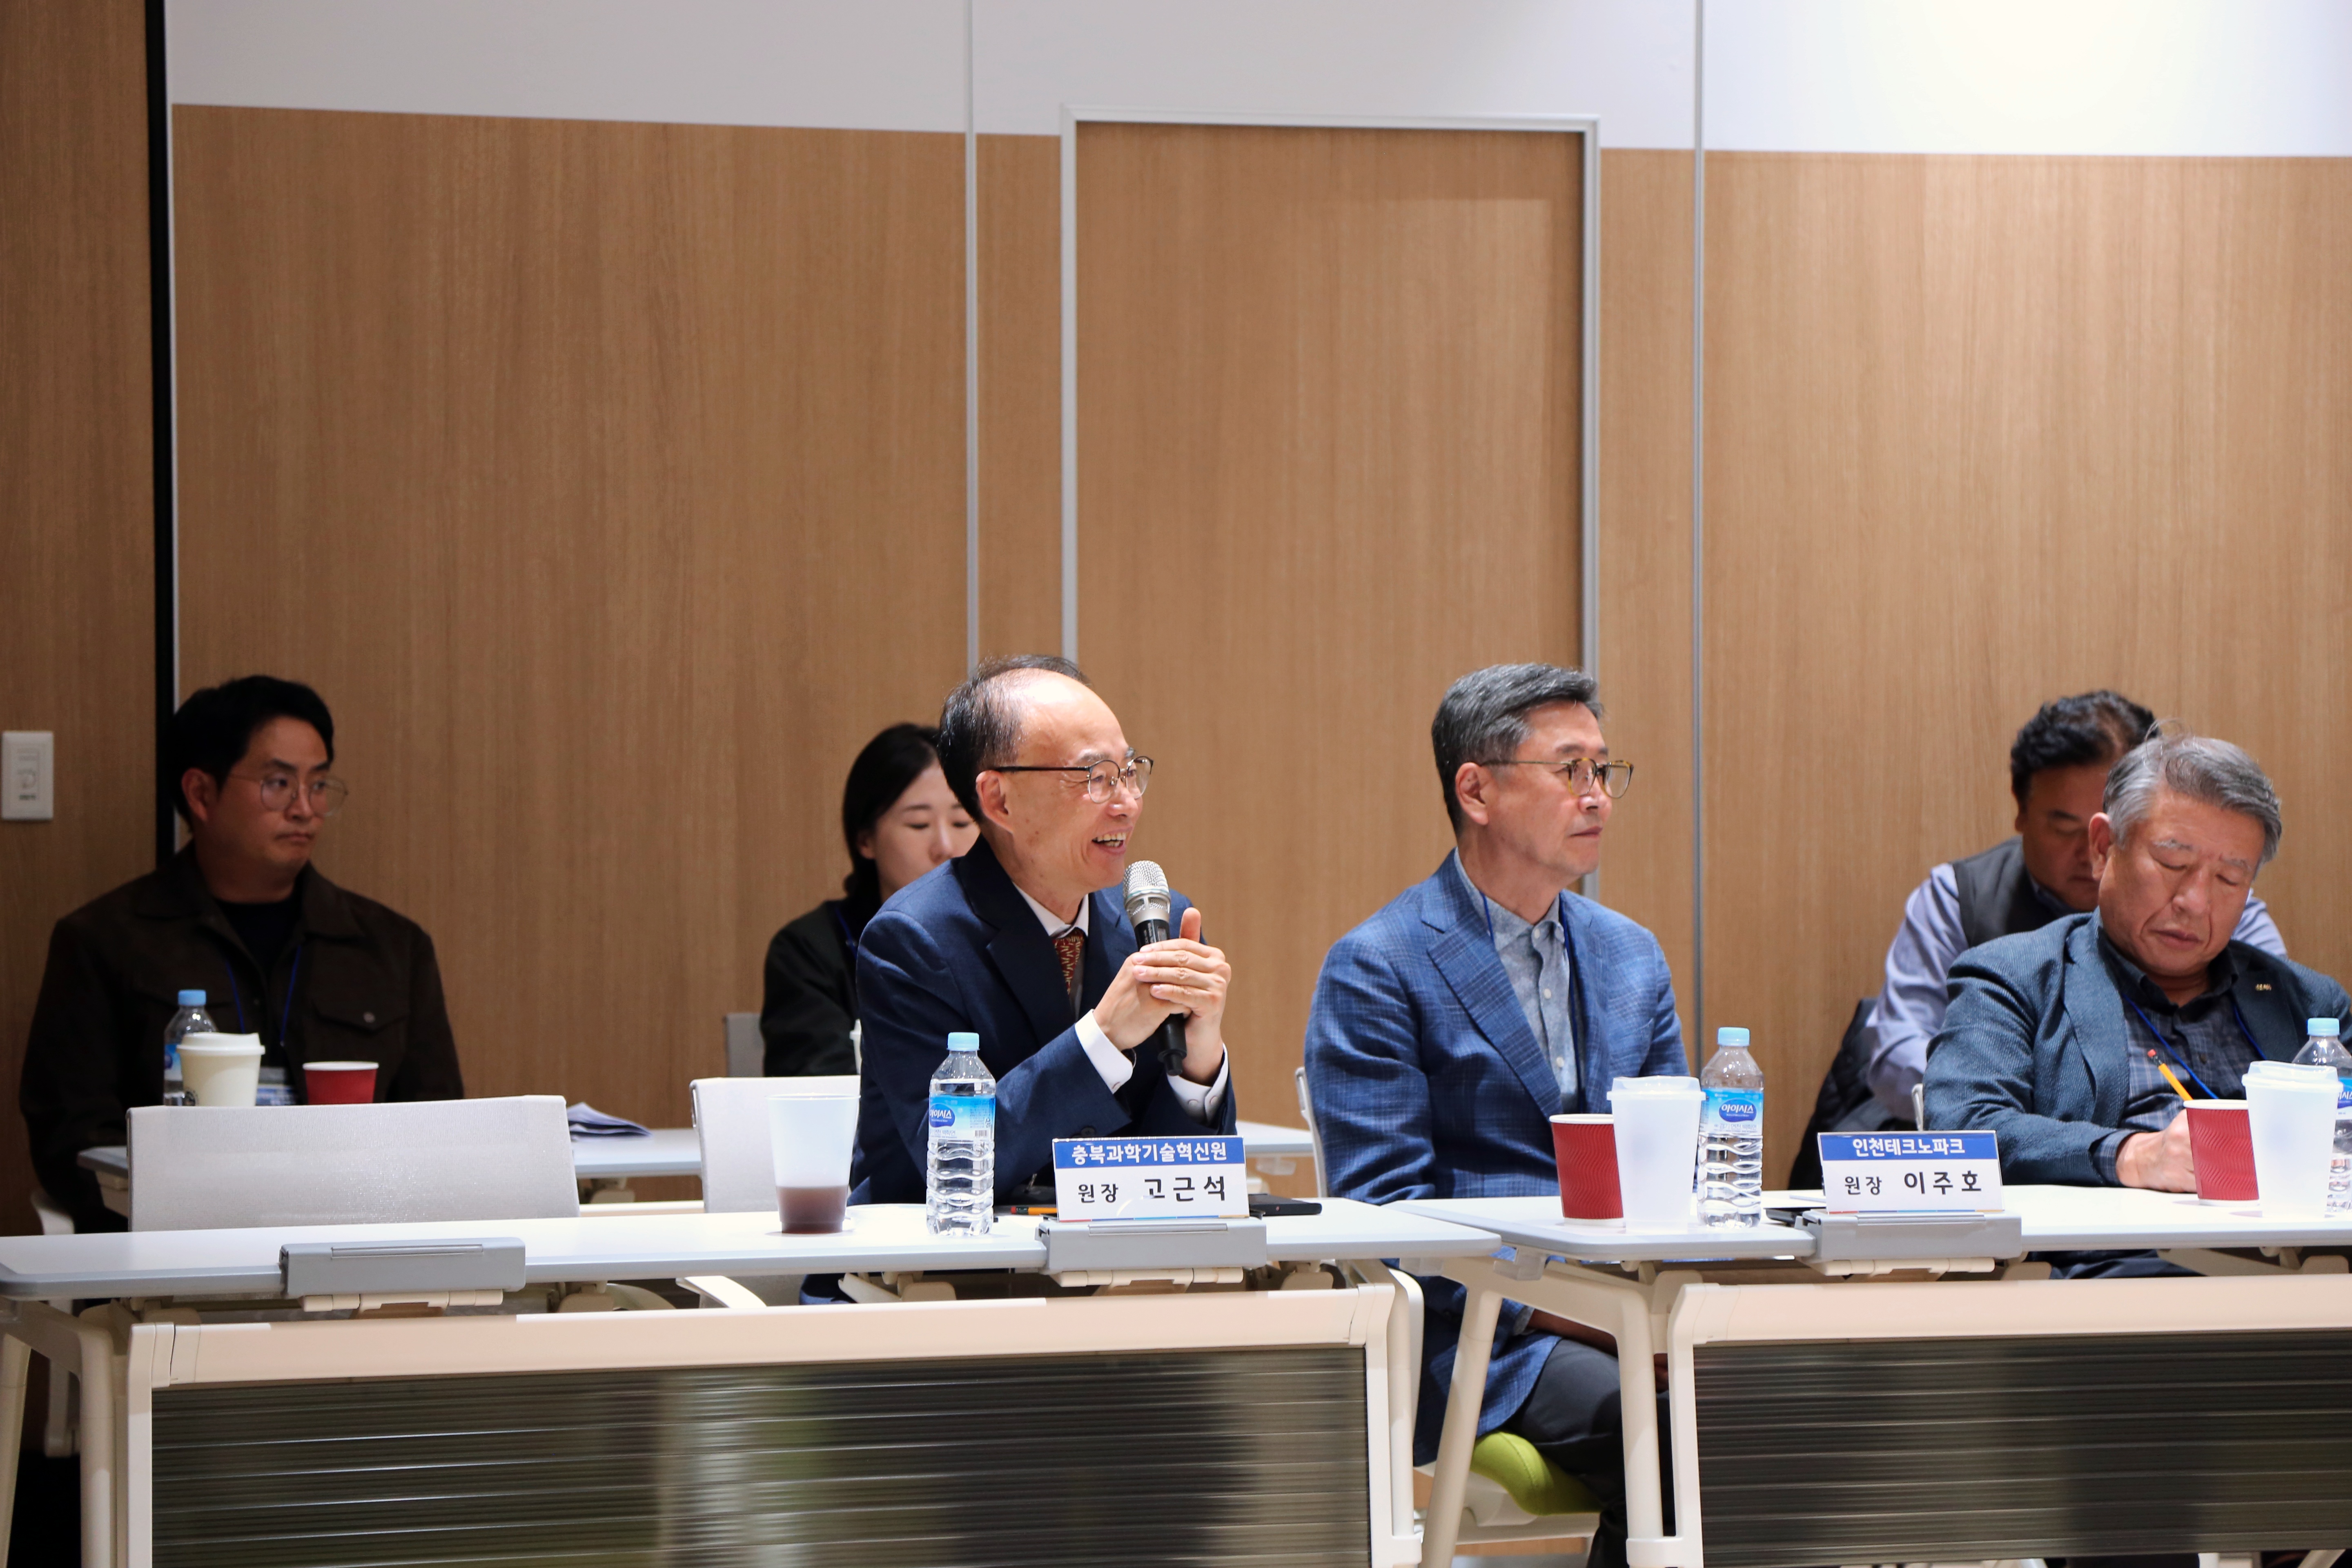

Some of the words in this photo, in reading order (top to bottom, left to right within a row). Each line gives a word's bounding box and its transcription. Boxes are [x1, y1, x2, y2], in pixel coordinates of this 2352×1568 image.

[1721, 1104, 1754, 1114] 아이시스
[1071, 1142, 1227, 1165] 충북과학기술혁신원
[1852, 1138, 1965, 1157] 인천테크노파크
[1078, 1183, 1119, 1203] 원장
[1144, 1176, 1225, 1202] 고근석
[1844, 1176, 1882, 1195] 원장
[1904, 1170, 1982, 1195] 이주호
